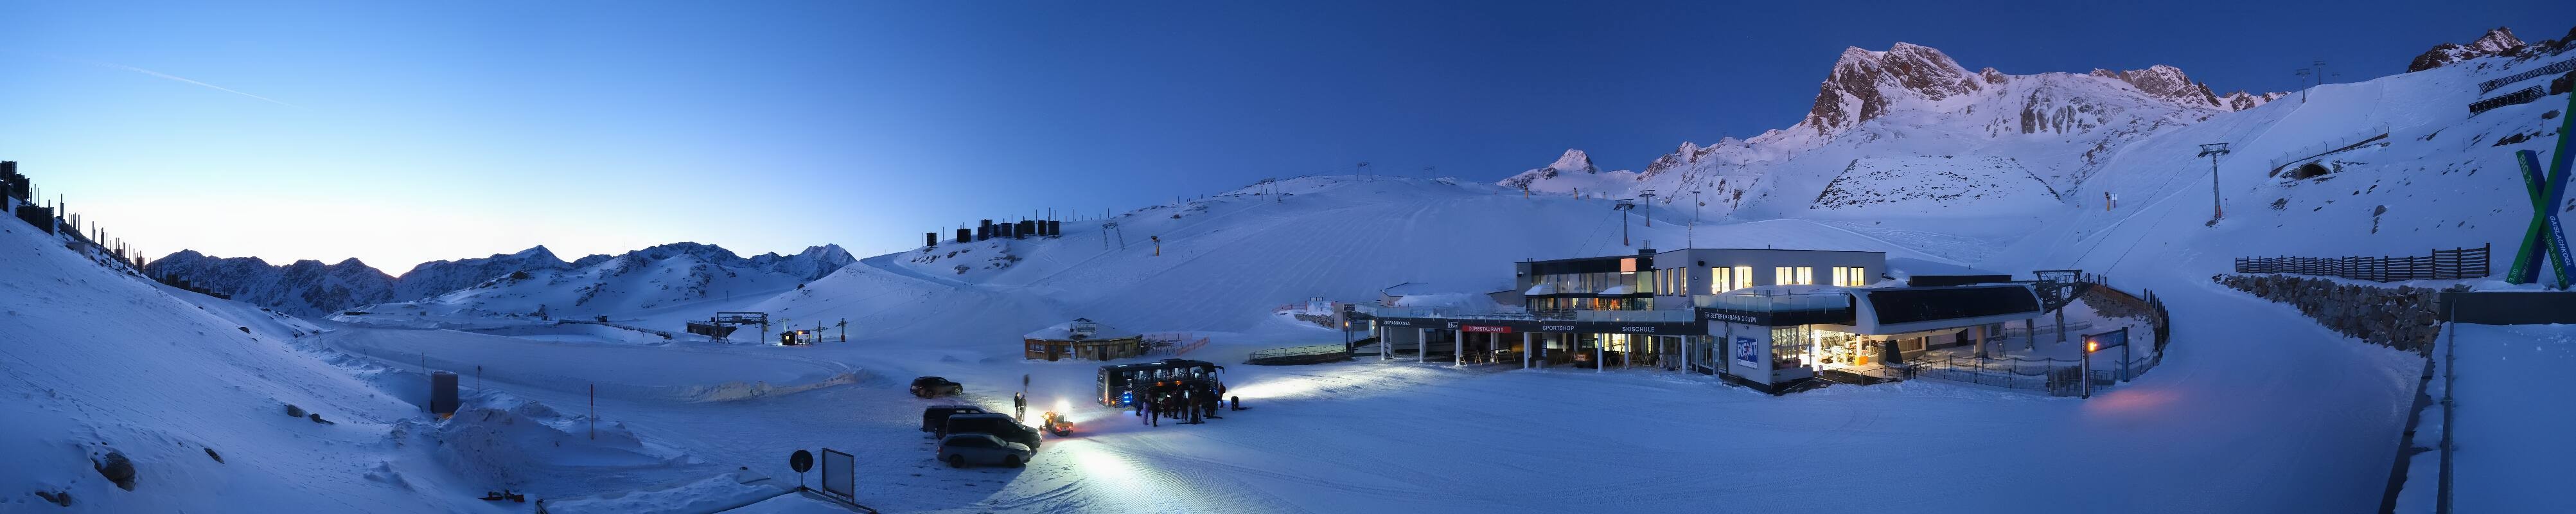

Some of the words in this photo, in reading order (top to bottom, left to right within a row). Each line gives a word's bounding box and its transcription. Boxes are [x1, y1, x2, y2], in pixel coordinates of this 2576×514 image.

[2519, 154, 2528, 175] BIG
[2526, 175, 2532, 184] 3
[2550, 216, 2572, 267] GAISLACHKOGL
[1737, 341, 1757, 357] RENT
